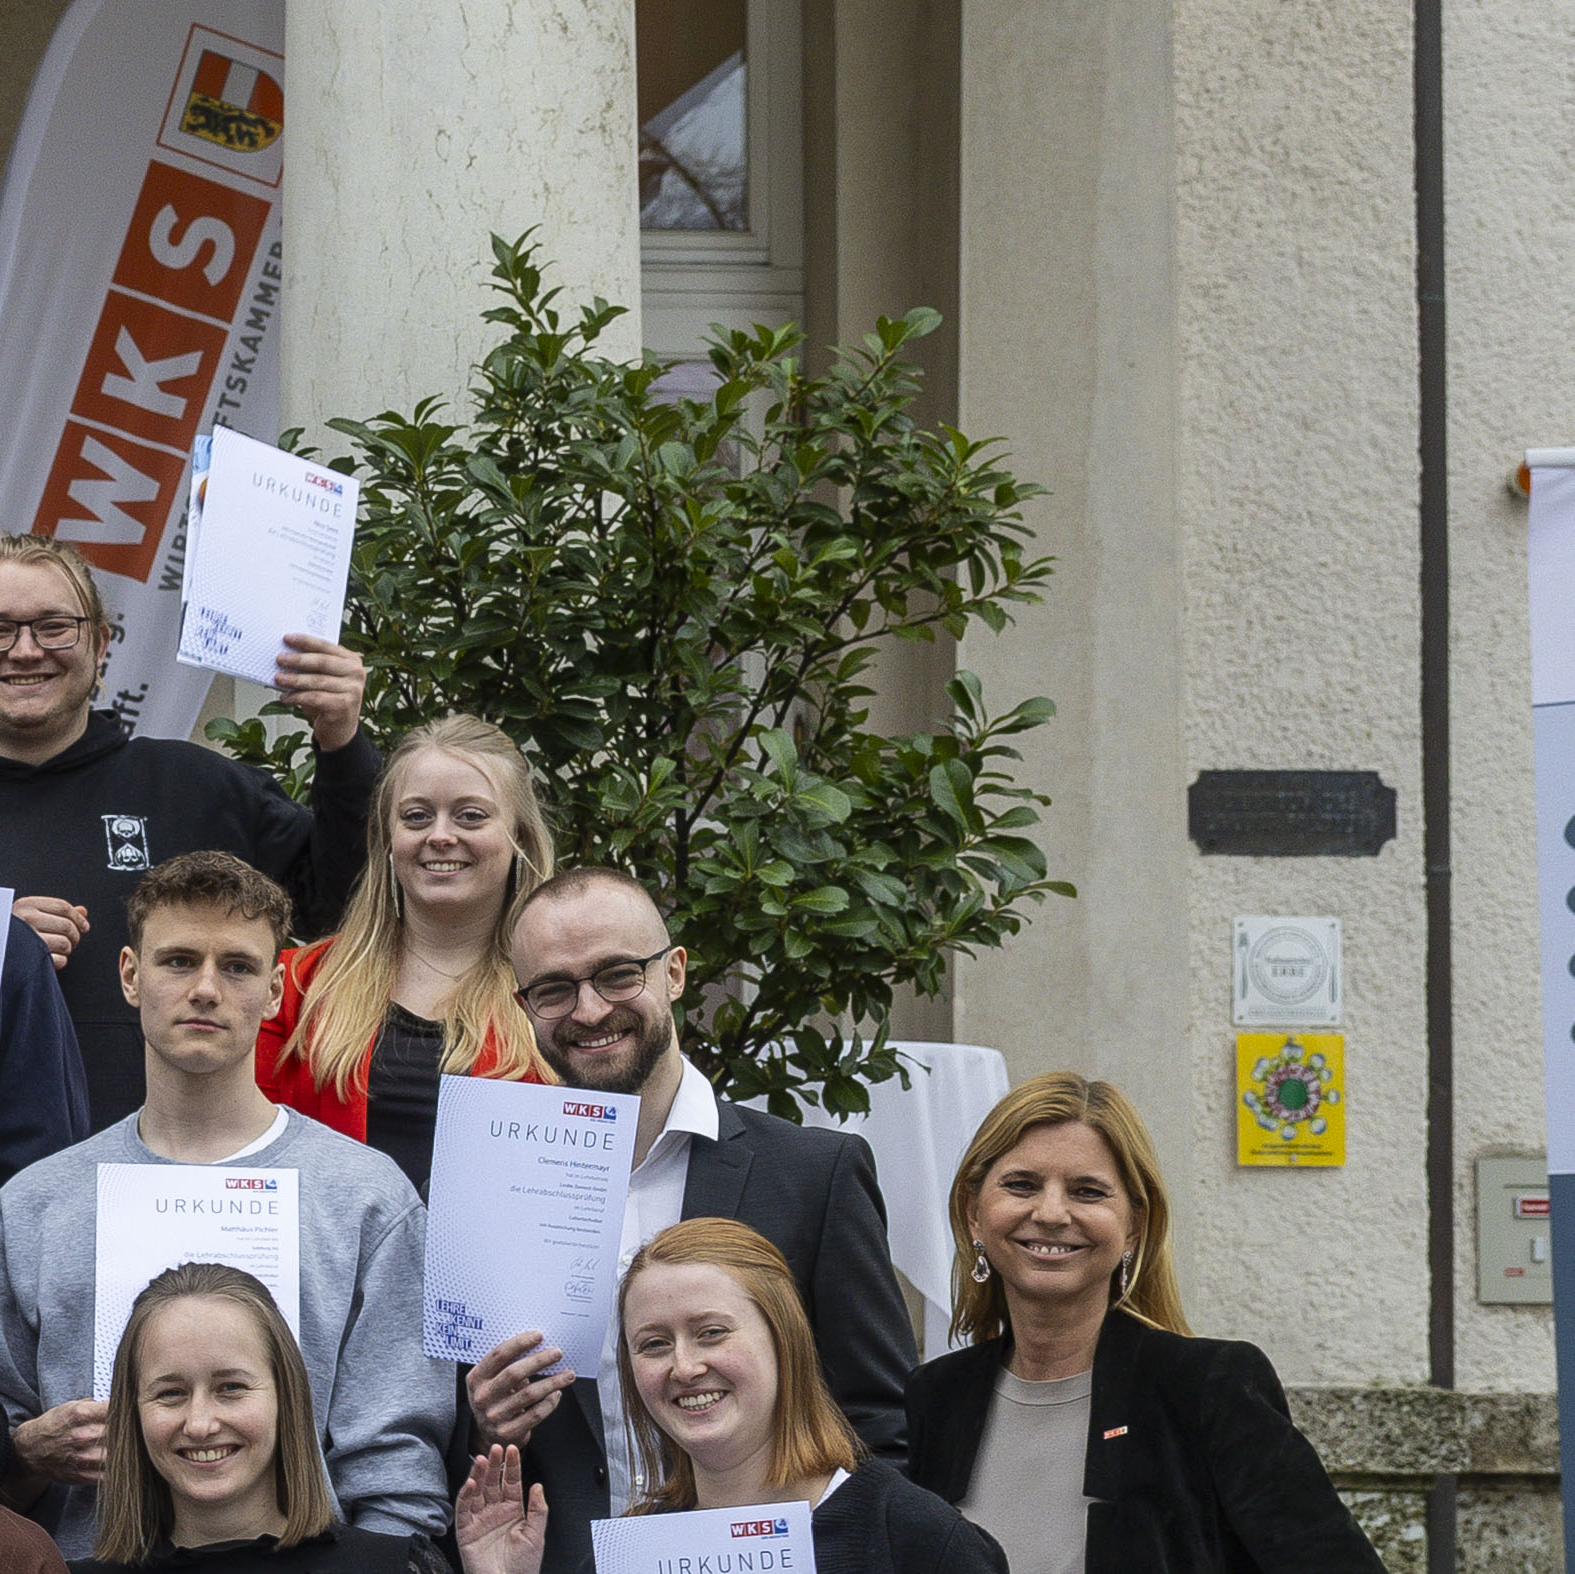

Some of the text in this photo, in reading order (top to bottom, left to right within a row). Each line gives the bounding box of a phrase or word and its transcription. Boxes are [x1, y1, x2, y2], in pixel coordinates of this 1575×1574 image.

[54, 204, 236, 546] WKS
[563, 1102, 602, 1118] WKS
[489, 1119, 615, 1151] URKUNDE
[225, 1179, 262, 1189] WKS
[155, 1197, 278, 1217] URKUNDE
[730, 1520, 772, 1537] WKS
